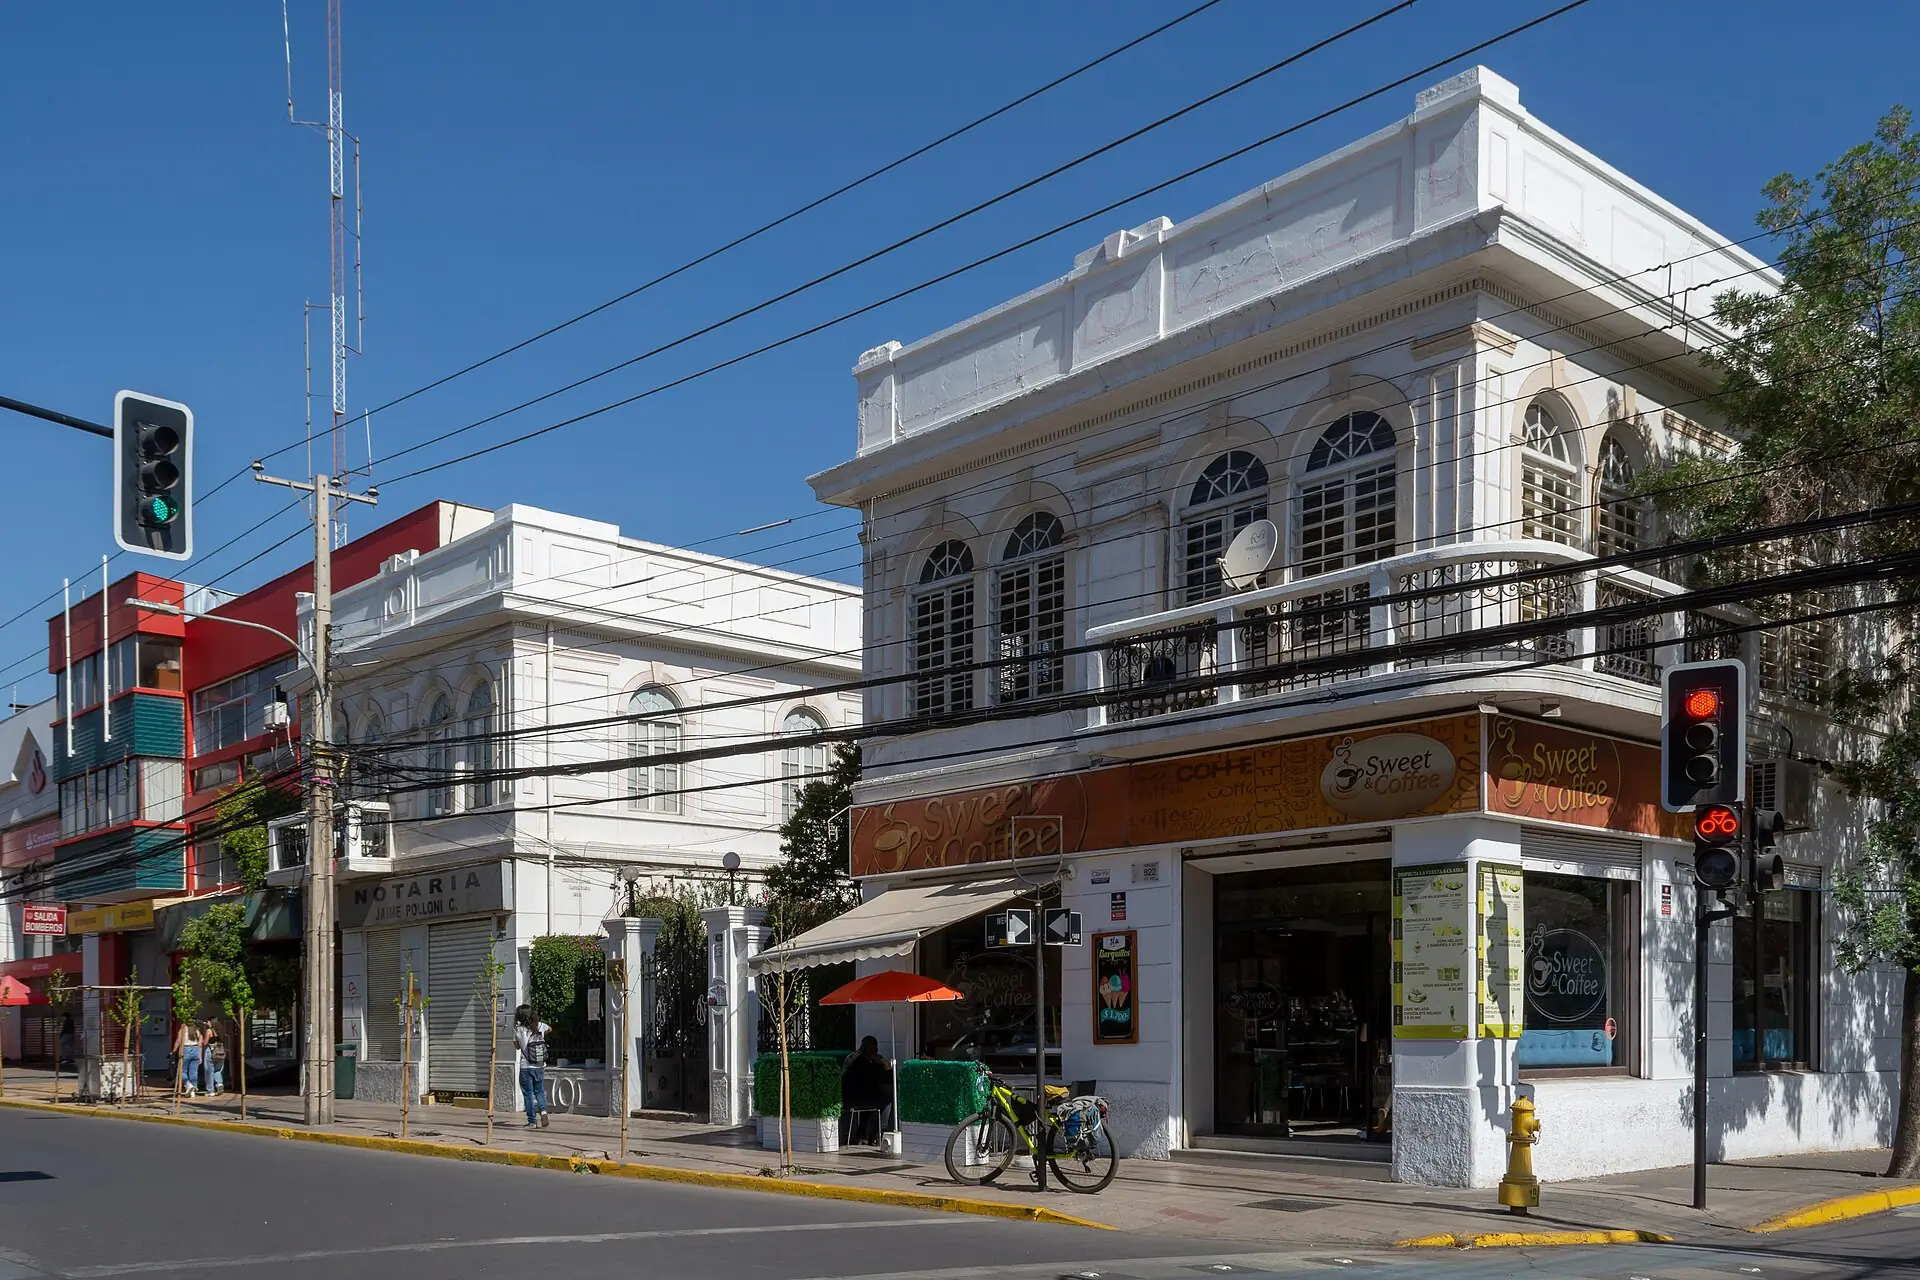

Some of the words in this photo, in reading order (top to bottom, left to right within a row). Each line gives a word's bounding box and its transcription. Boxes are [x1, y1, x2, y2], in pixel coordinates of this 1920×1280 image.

[1365, 750, 1432, 776] Sweet
[1533, 740, 1598, 778] Sweet
[1364, 778, 1373, 789] &
[1374, 770, 1440, 795] Coffee
[1533, 783, 1544, 802] &
[1544, 773, 1608, 813] Coffee
[924, 784, 1037, 841] Sweet
[924, 846, 939, 868] &
[941, 820, 1059, 867] Coffee
[354, 871, 481, 904] NOTARIA
[33, 911, 58, 921] SALIDA
[375, 905, 401, 921] JAIME
[406, 900, 443, 917] POLLONI
[25, 922, 63, 932] BOMBEROS
[1553, 951, 1594, 974] Sweet
[977, 972, 1024, 989] Sweet
[1552, 974, 1558, 987] &
[1558, 973, 1598, 995] Coffee
[984, 989, 1032, 1008] Coffee
[1243, 990, 1271, 1000] Sweet
[1246, 1000, 1275, 1009] Coffee
